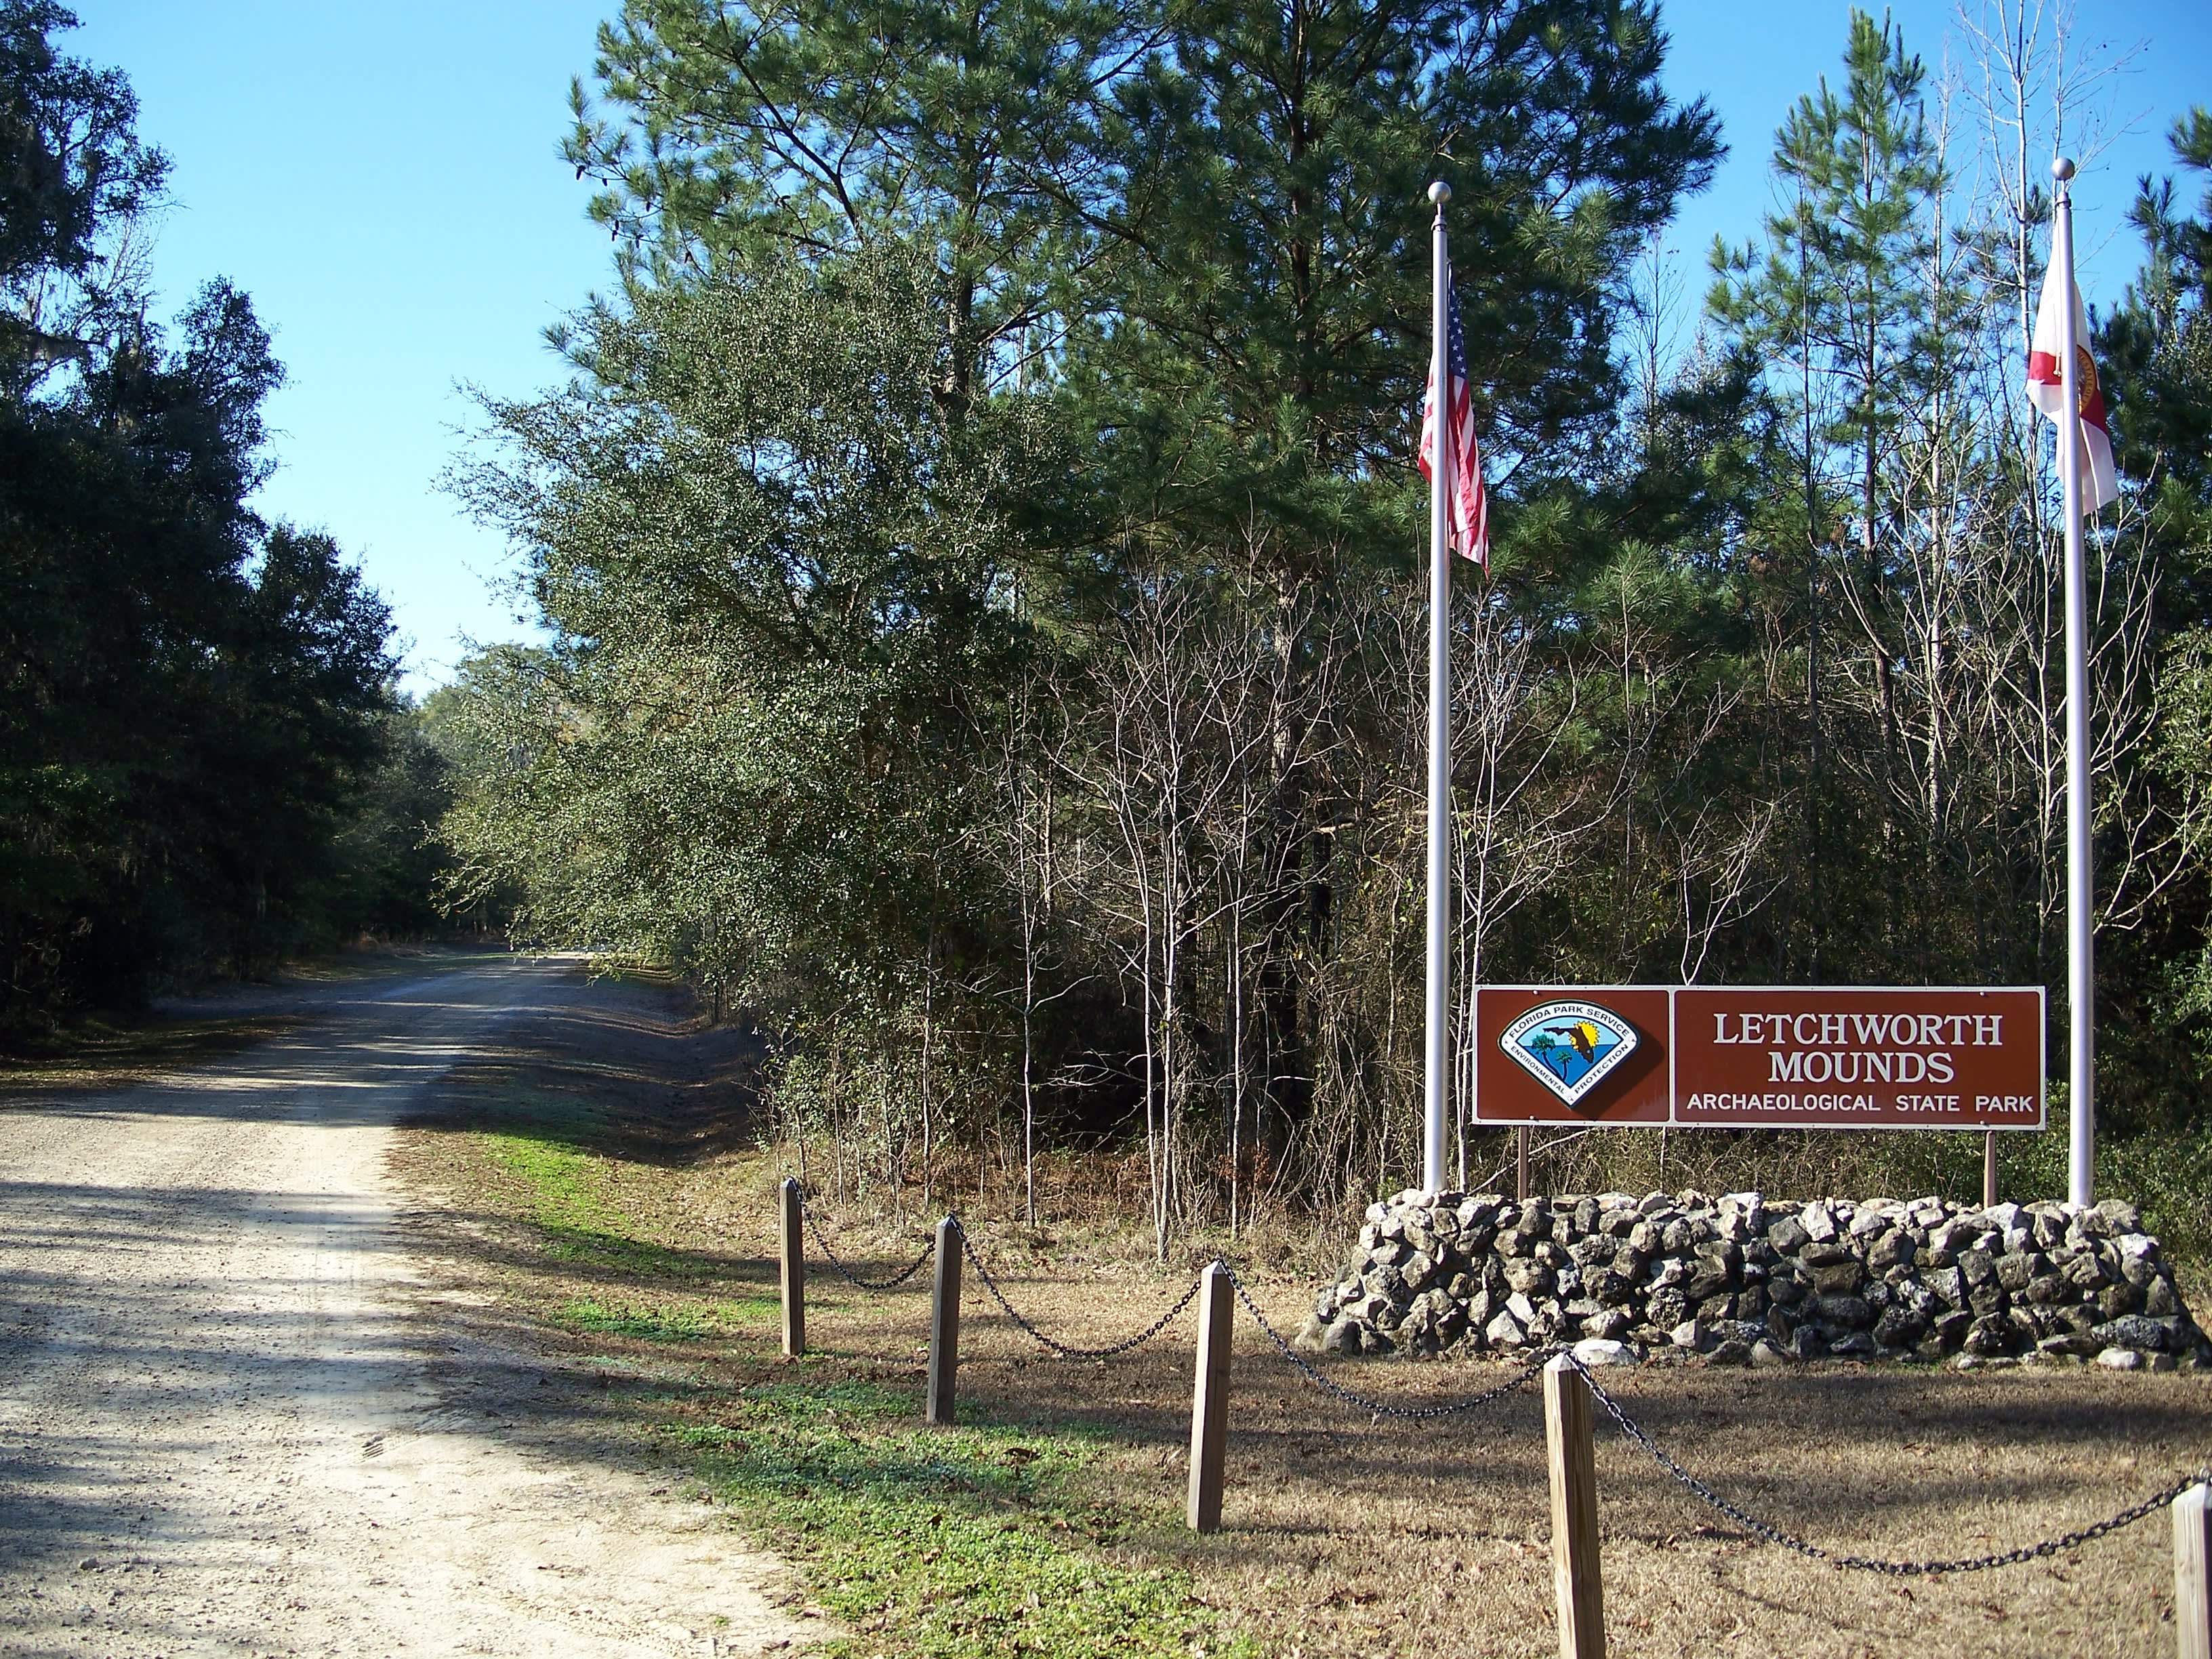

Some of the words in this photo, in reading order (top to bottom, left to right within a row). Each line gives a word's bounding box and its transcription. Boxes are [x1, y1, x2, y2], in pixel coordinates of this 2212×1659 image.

[1509, 1009, 1551, 1038] FLORIDA
[1554, 1006, 1583, 1014] PARK
[1586, 1008, 1630, 1037] SERVICE
[1713, 1013, 2003, 1046] LETCHWORTH
[1511, 1046, 1565, 1094] ENVIRONMENTAL
[1574, 1044, 1629, 1094] PROTECTION
[1767, 1051, 1954, 1084] MOUNDS
[1687, 1093, 1881, 1111] ARCHAEOLOGICAL
[1896, 1094, 1961, 1111] STATE
[1975, 1095, 2033, 1112] PARK
